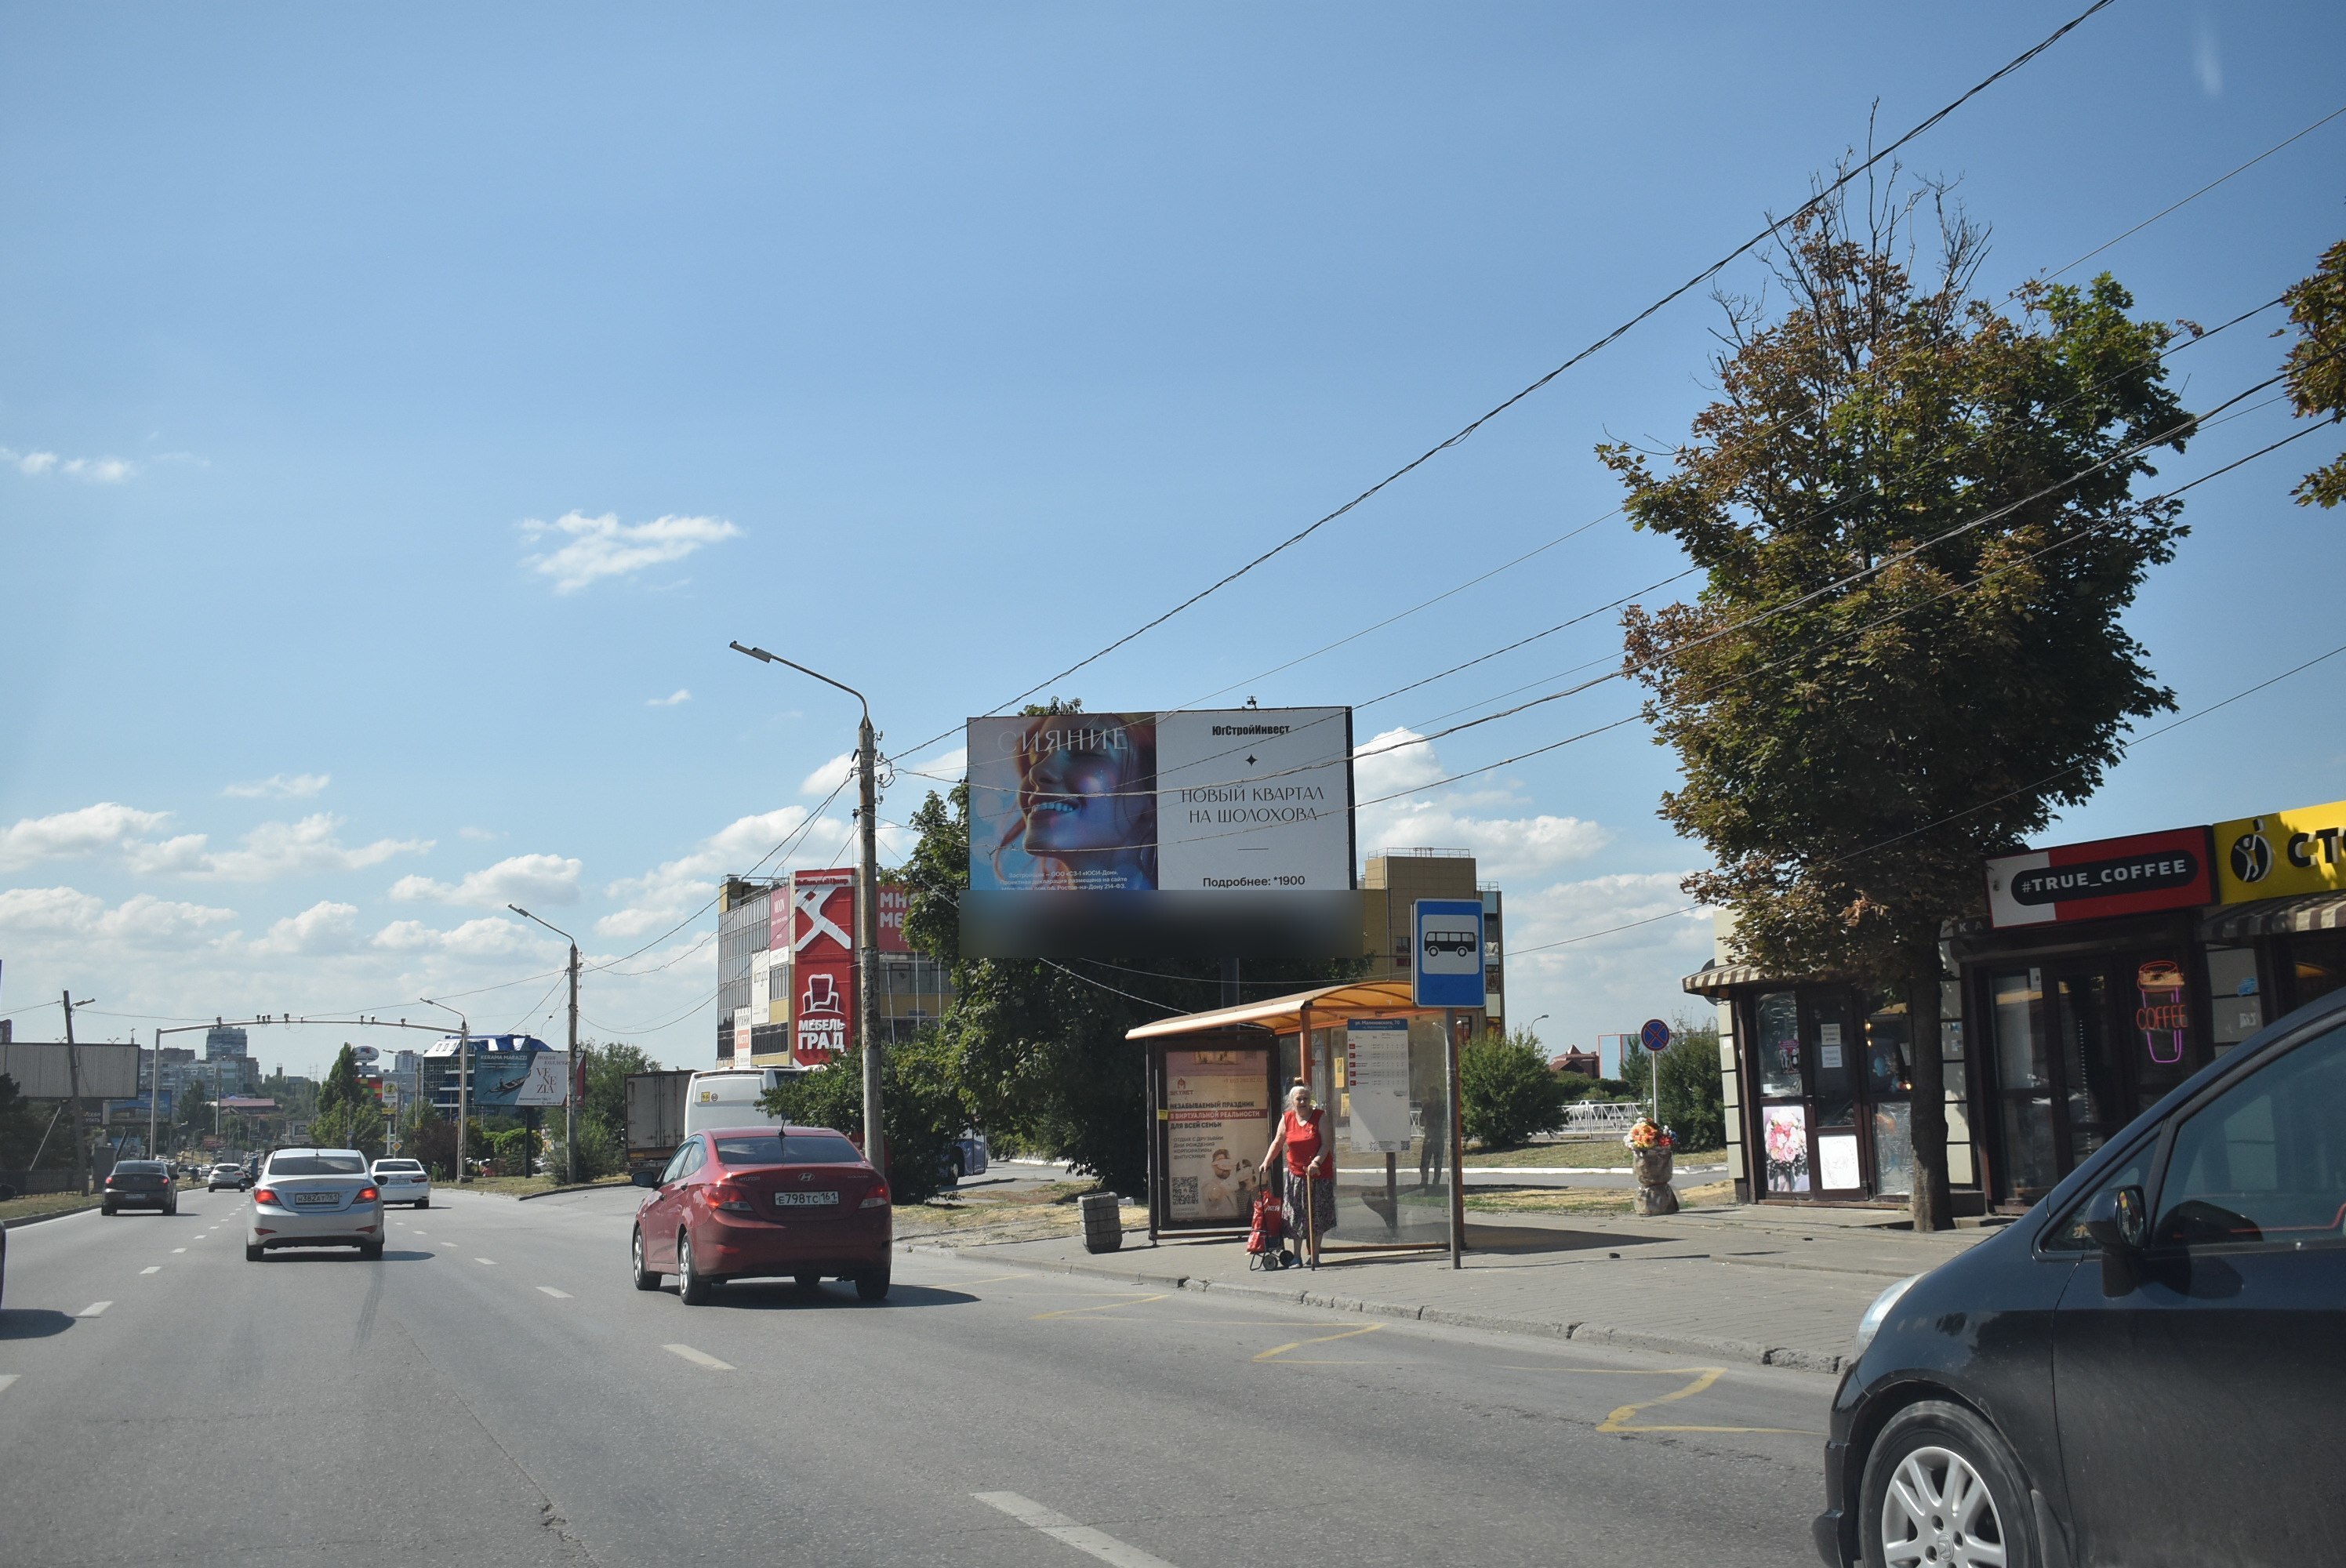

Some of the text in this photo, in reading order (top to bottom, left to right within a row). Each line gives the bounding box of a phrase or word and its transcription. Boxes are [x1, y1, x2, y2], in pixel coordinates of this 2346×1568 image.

[1211, 724, 1291, 736] ЮгСтройИнвест
[997, 728, 1128, 753] СИЯНИЕ
[1182, 784, 1324, 803] НОВЫЙ КВАРТАЛ
[1189, 807, 1317, 823] НА ШОЛОХОВА
[2286, 826, 2346, 869] СТ
[1203, 877, 1271, 888] Подробнее:
[2021, 858, 2188, 894] #TRUE_COFFEE
[797, 1018, 846, 1032] МЕБЕЛЬ
[2137, 1004, 2188, 1030] COFFEE
[797, 1031, 845, 1053] ГРАД
[1170, 1101, 1221, 1109] НЕЗАБЫВАЕМЫЙ
